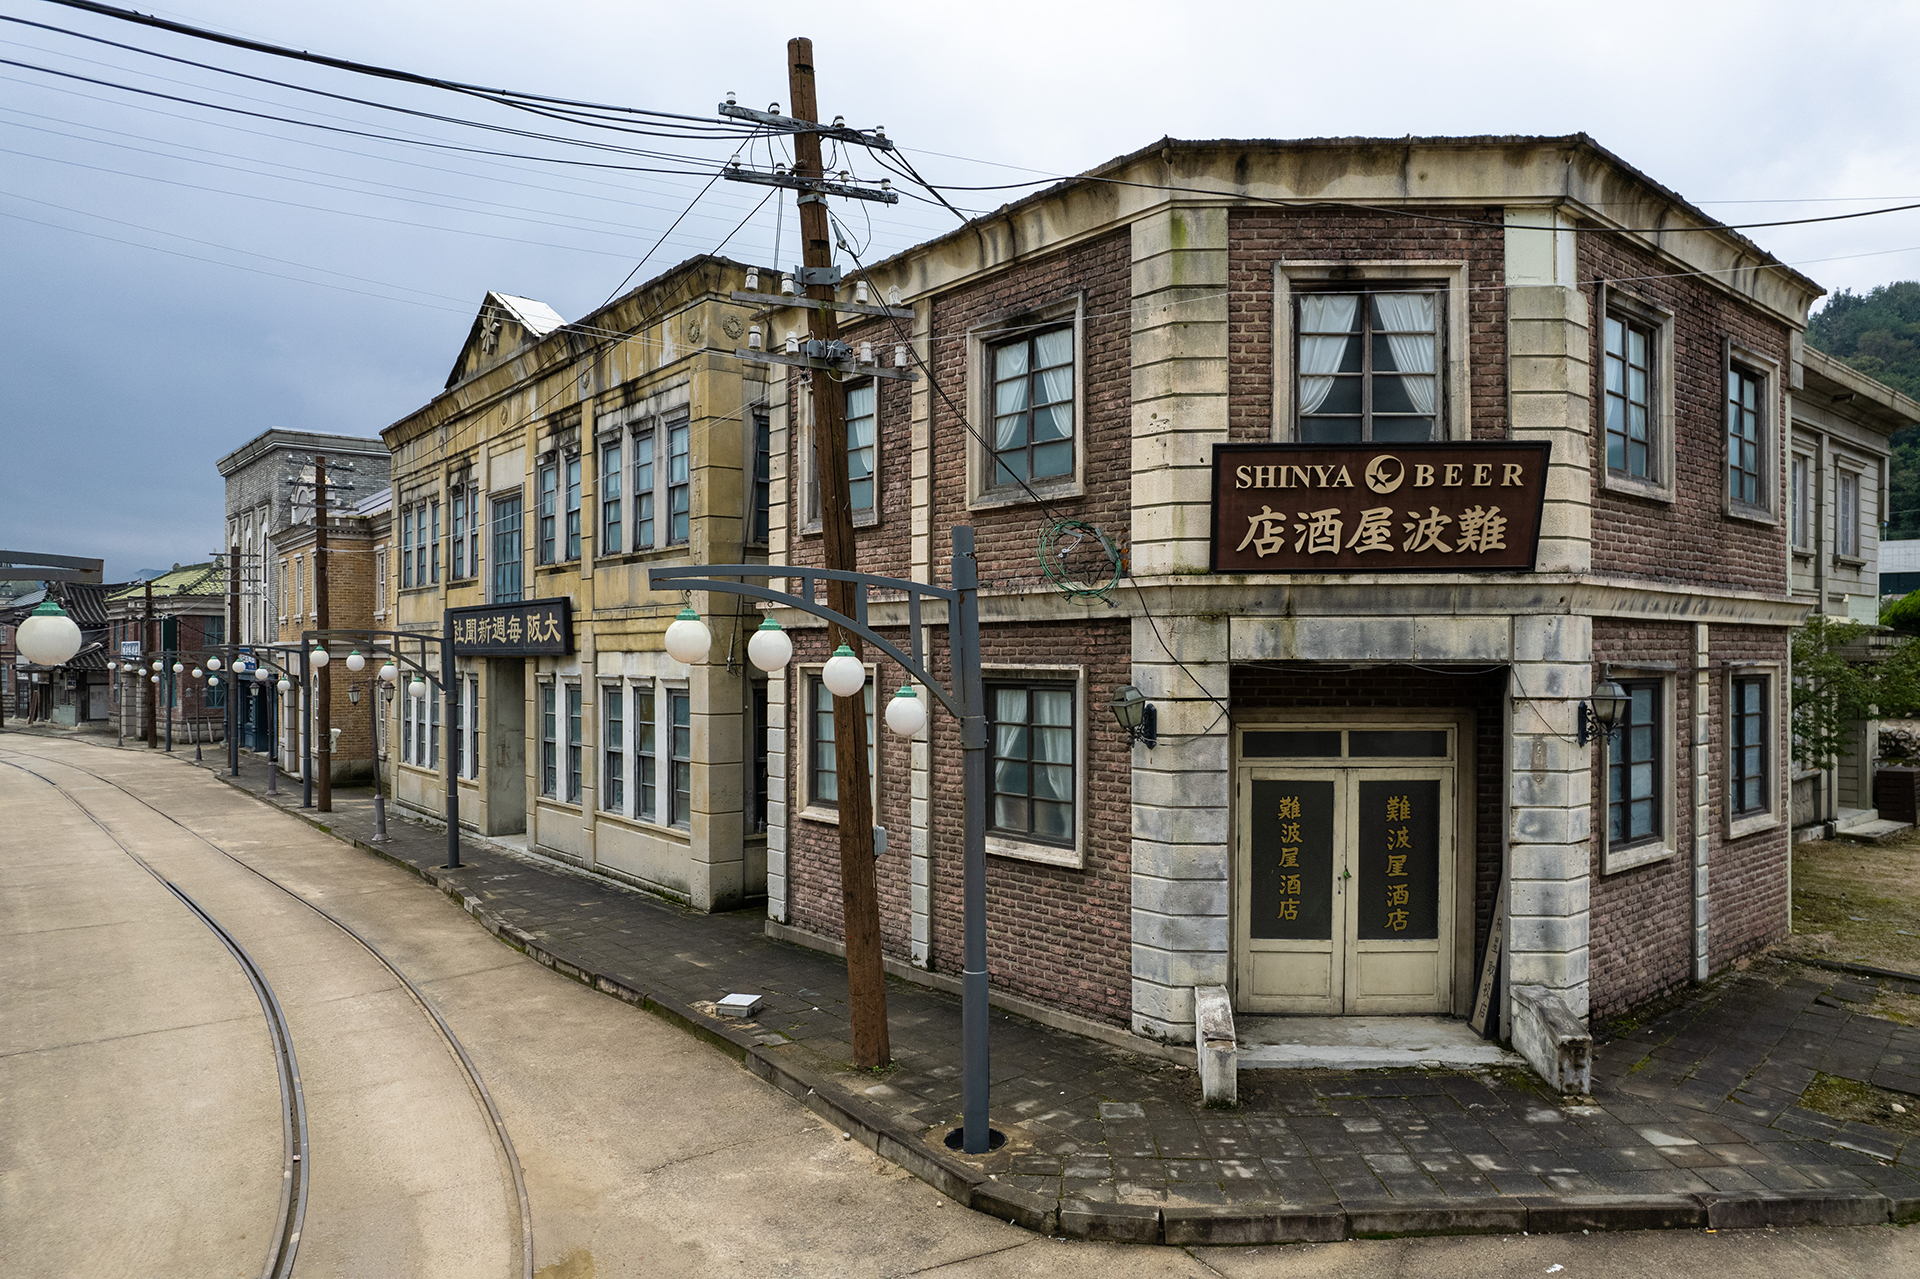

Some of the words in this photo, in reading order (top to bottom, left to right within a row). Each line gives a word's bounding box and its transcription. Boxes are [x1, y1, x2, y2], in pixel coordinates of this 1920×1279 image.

[1235, 464, 1355, 490] SHINYA
[1413, 463, 1525, 488] BEER
[1276, 795, 1304, 921] 難波屋酒店
[1383, 795, 1413, 932] 難波屋酒店
